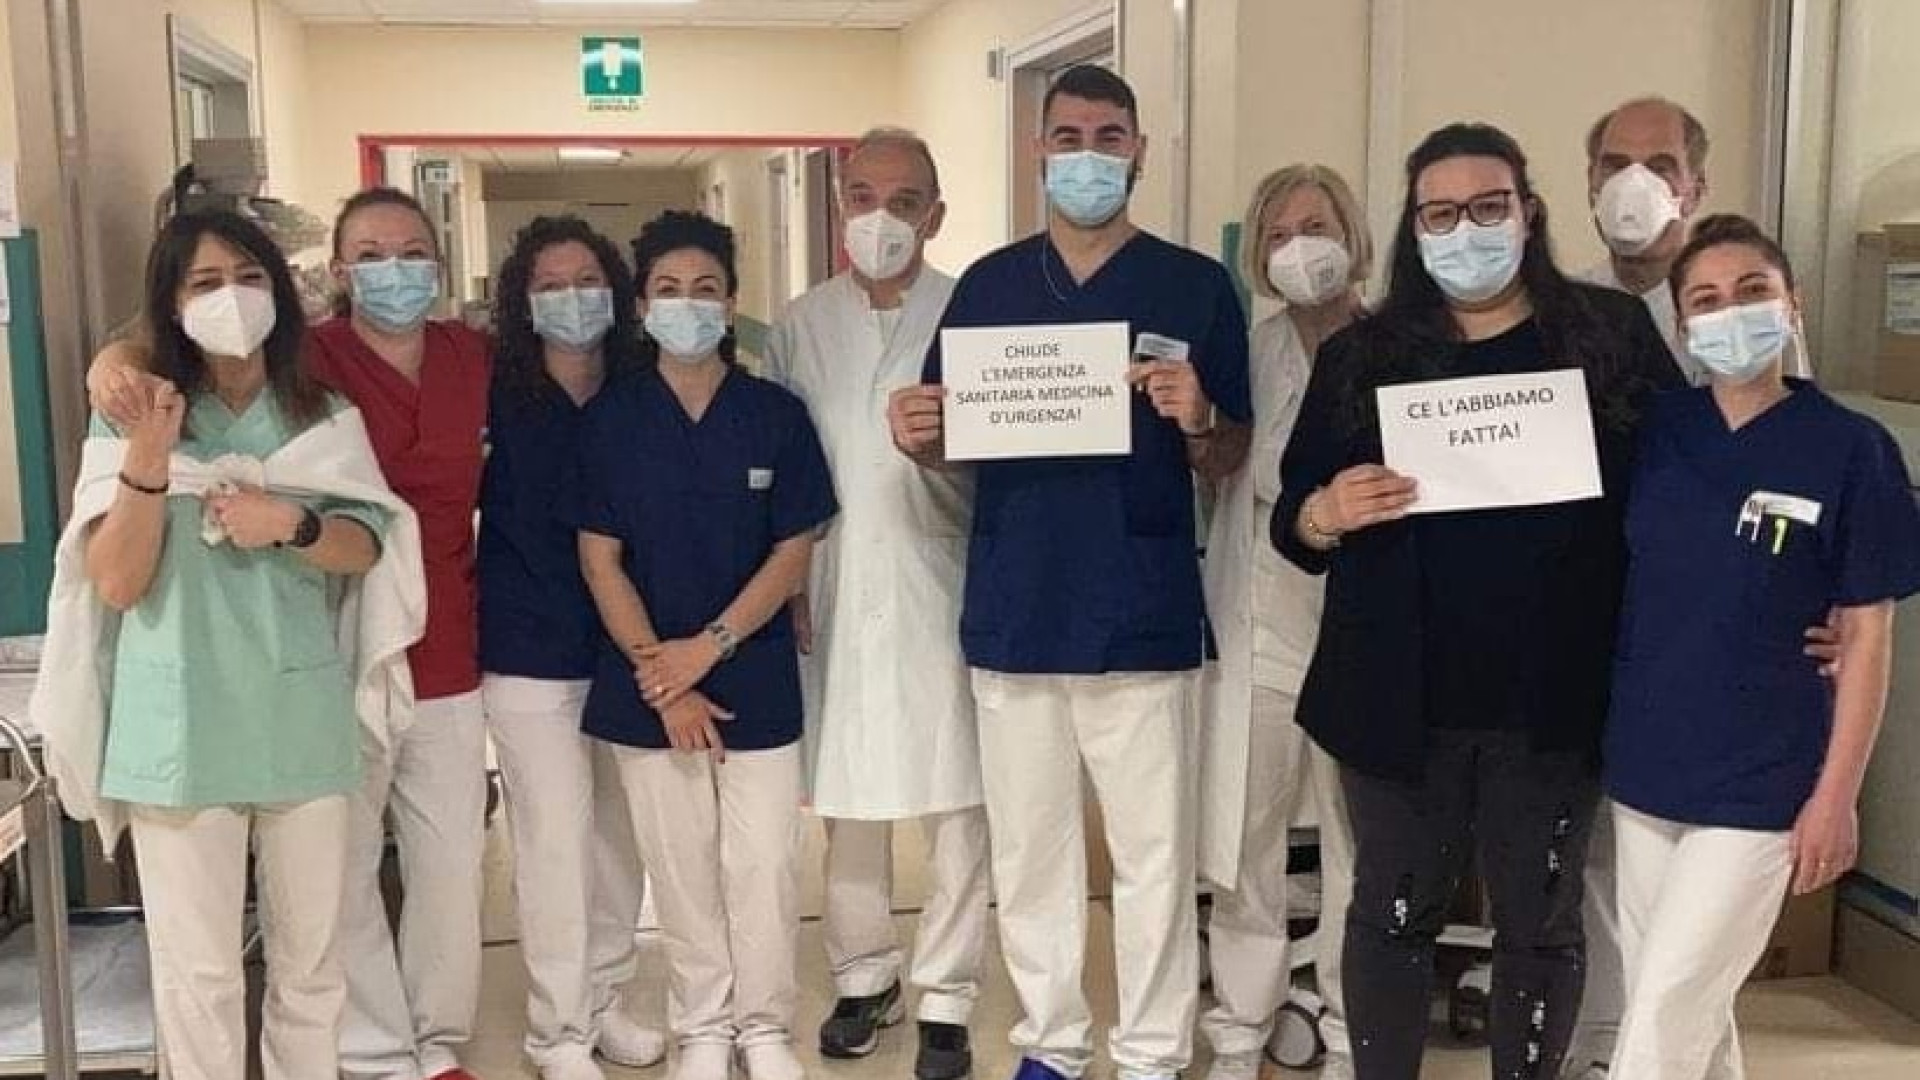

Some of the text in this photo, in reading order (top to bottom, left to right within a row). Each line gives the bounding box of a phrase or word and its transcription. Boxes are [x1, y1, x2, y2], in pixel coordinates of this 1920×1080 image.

[1005, 343, 1060, 359] CHIUDE
[981, 364, 1086, 382] L'EMERGENZA
[956, 385, 1113, 405] SANITARIA MEDICINA
[1407, 387, 1554, 419] CE L'ABBIAMO
[989, 408, 1081, 424] D'URGENZA!
[1448, 421, 1521, 446] FATTA!
